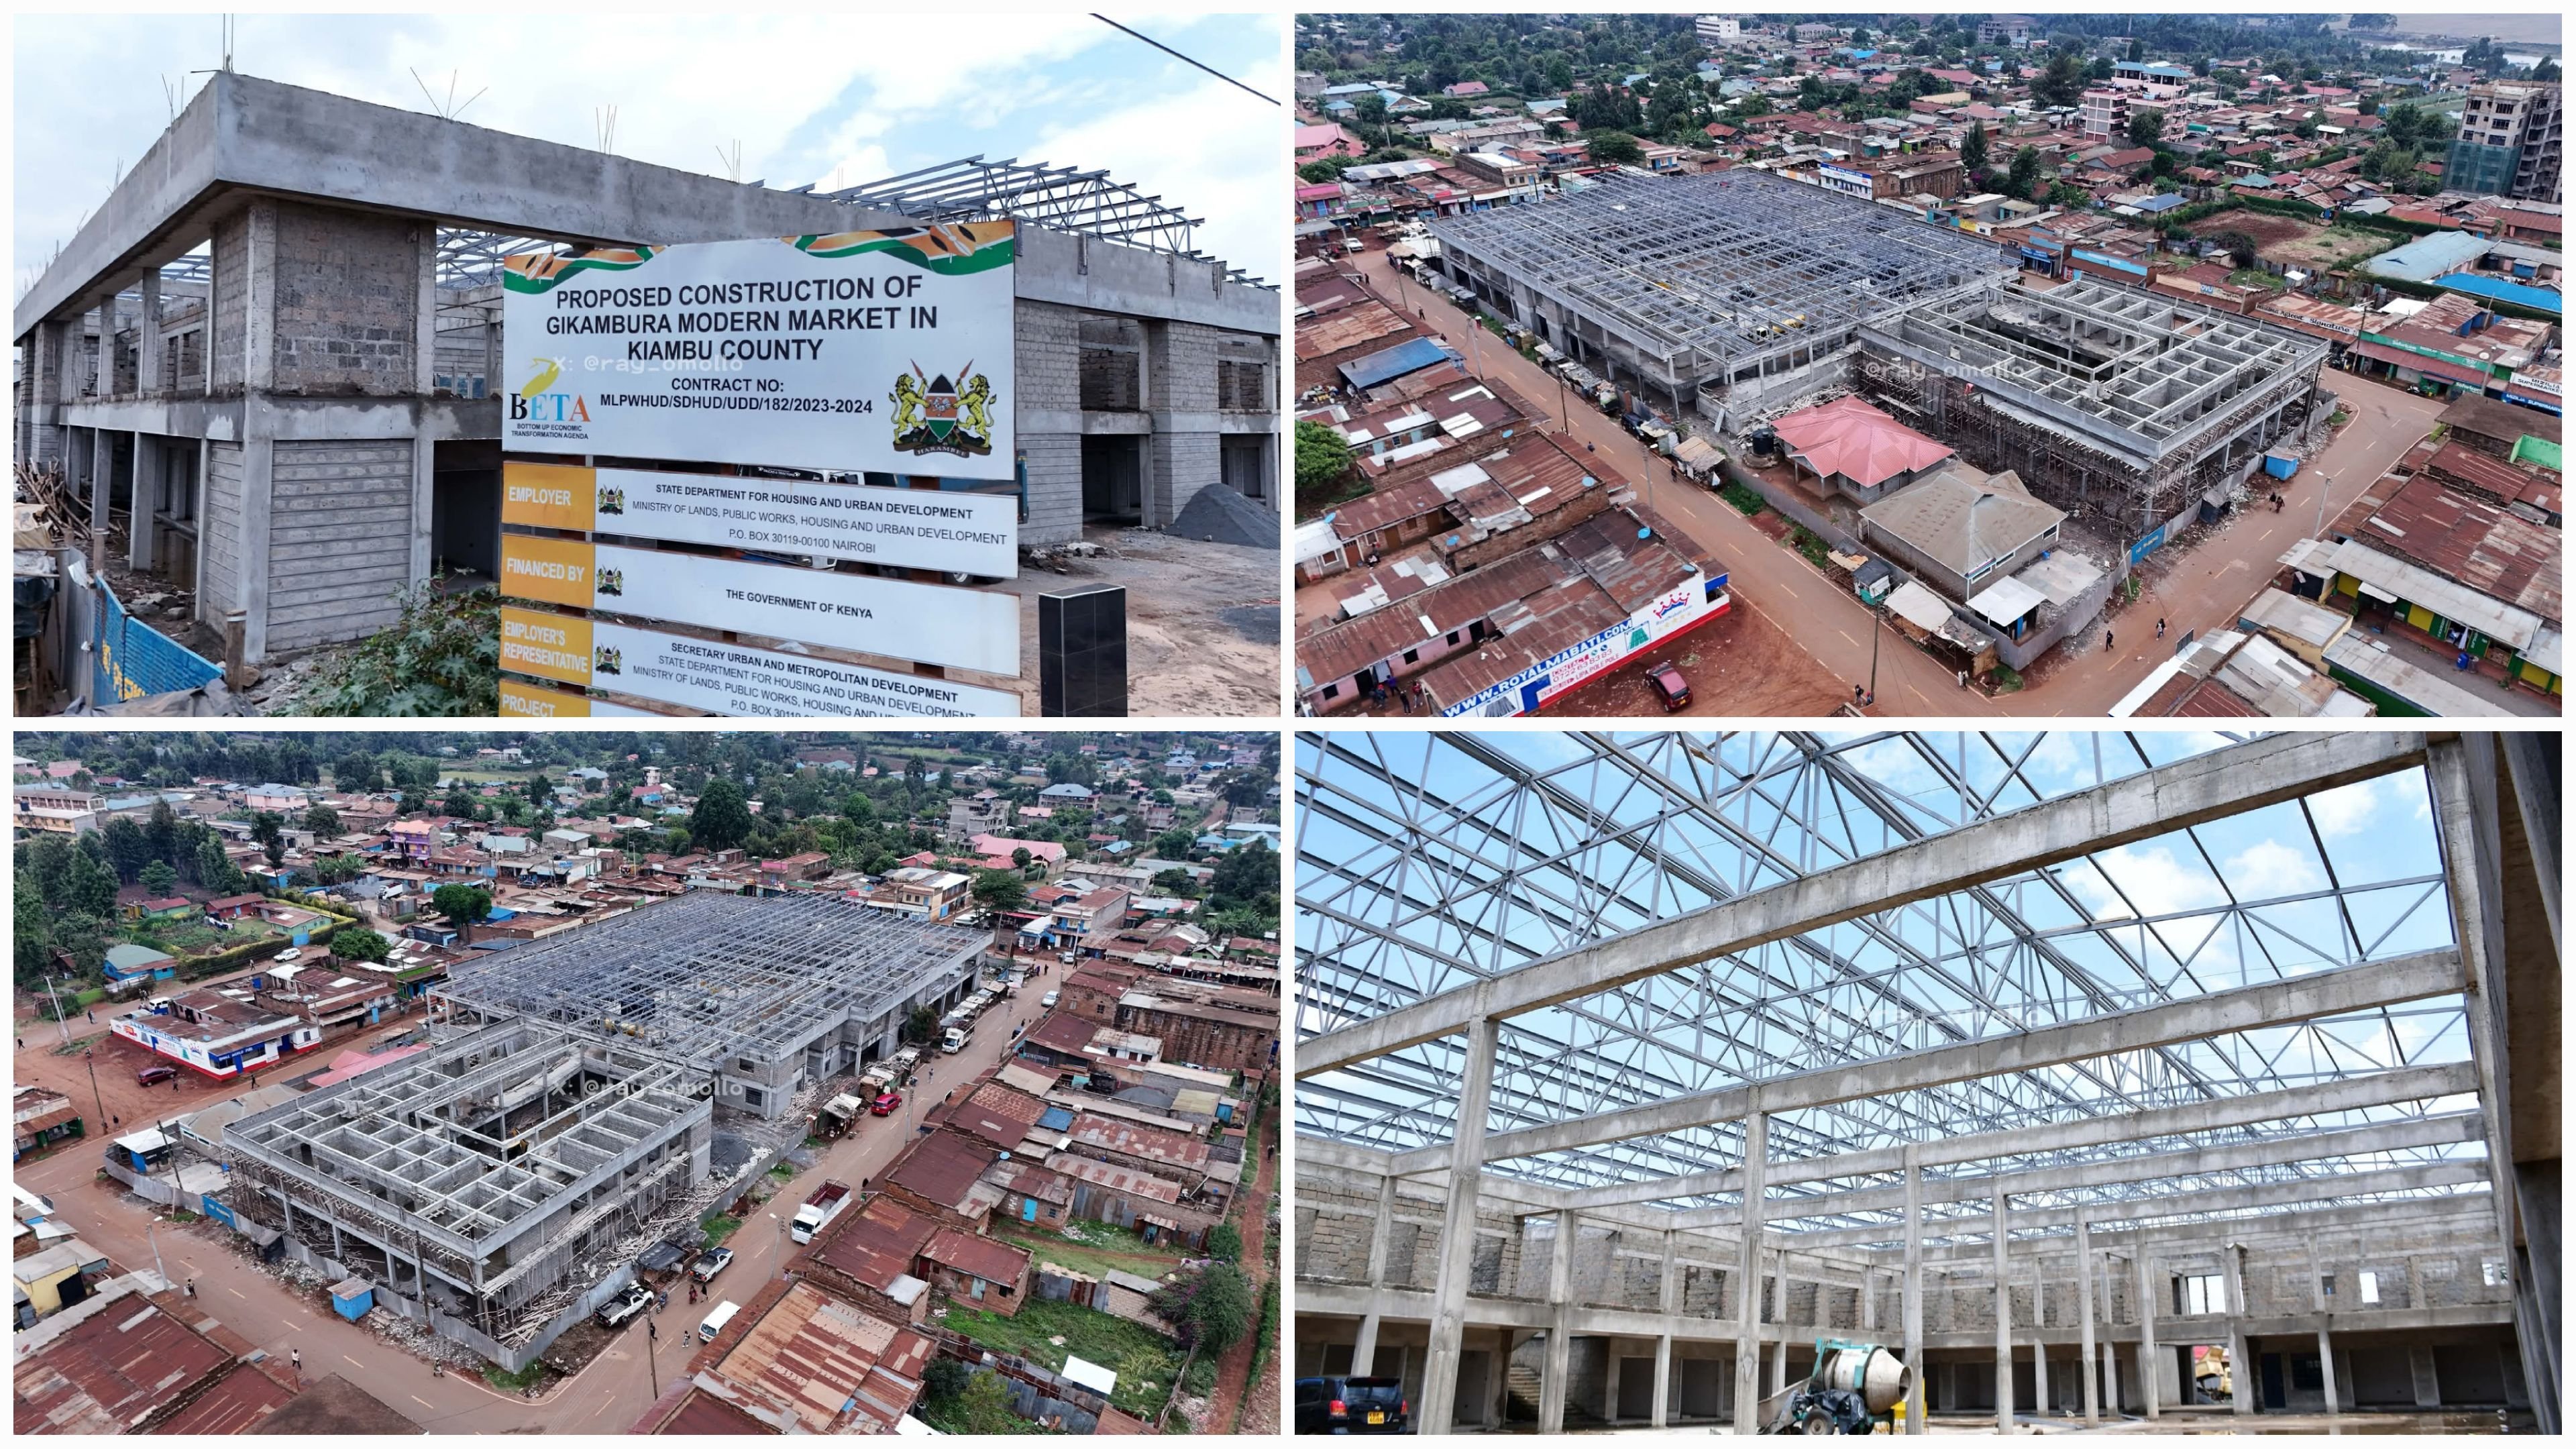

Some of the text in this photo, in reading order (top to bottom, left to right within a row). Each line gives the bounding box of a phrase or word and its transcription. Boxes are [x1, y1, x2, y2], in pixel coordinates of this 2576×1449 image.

[557, 275, 923, 309] PROPOSED CONSTRUCTION OF
[547, 305, 937, 335] GIKAMBURA MODERN MARKET IN
[628, 338, 824, 361] KIAMBU COUNTY
[672, 378, 784, 392] CONTRACT NO:
[508, 393, 591, 422] BETA
[600, 394, 873, 415] MLPWHUD/SDHUD/UDD/182/2023-2024
[917, 446, 967, 456] HARAMBEE
[508, 486, 572, 506] EMPLOYER
[656, 484, 973, 519] STATE DEPARTMENT FOR HOUSING AND URBAN DEVELOPMENT
[633, 501, 1007, 545] MINISTRY OF LANDS, PUBLIC WORKS, HOUSING AND URBAN DEVELOPMENT
[729, 529, 875, 553] P.O. BOX 30119-00100 NAIROBI
[507, 557, 585, 582] FINANCED BY
[726, 589, 873, 619] THE GOVERNMENT OF KENYA
[504, 621, 566, 646] EMPLOYER'S
[504, 642, 588, 673] REPRESENTATIVE
[1444, 619, 1633, 716] WWW.ROYALMABATI.COM
[659, 655, 684, 668] STATE
[688, 660, 749, 680] DEPARTMENT
[751, 672, 771, 684] FOR
[773, 676, 820, 694] HOUSING
[822, 686, 845, 698] AND
[848, 690, 885, 706] URBAN
[672, 643, 958, 703] SECRETARY URBAN AND METROPOLITAN DEVELOPMENT
[502, 694, 555, 717] PROJECT
[633, 665, 673, 680] MINISTRY
[676, 672, 688, 683] OF
[690, 676, 722, 692] LANDS,
[724, 682, 759, 697] PUBLIC
[761, 690, 800, 707] WORKS,
[803, 698, 851, 716] HOUSING
[853, 708, 877, 717] AND
[731, 700, 748, 711] P.O.
[751, 704, 771, 717] BOX
